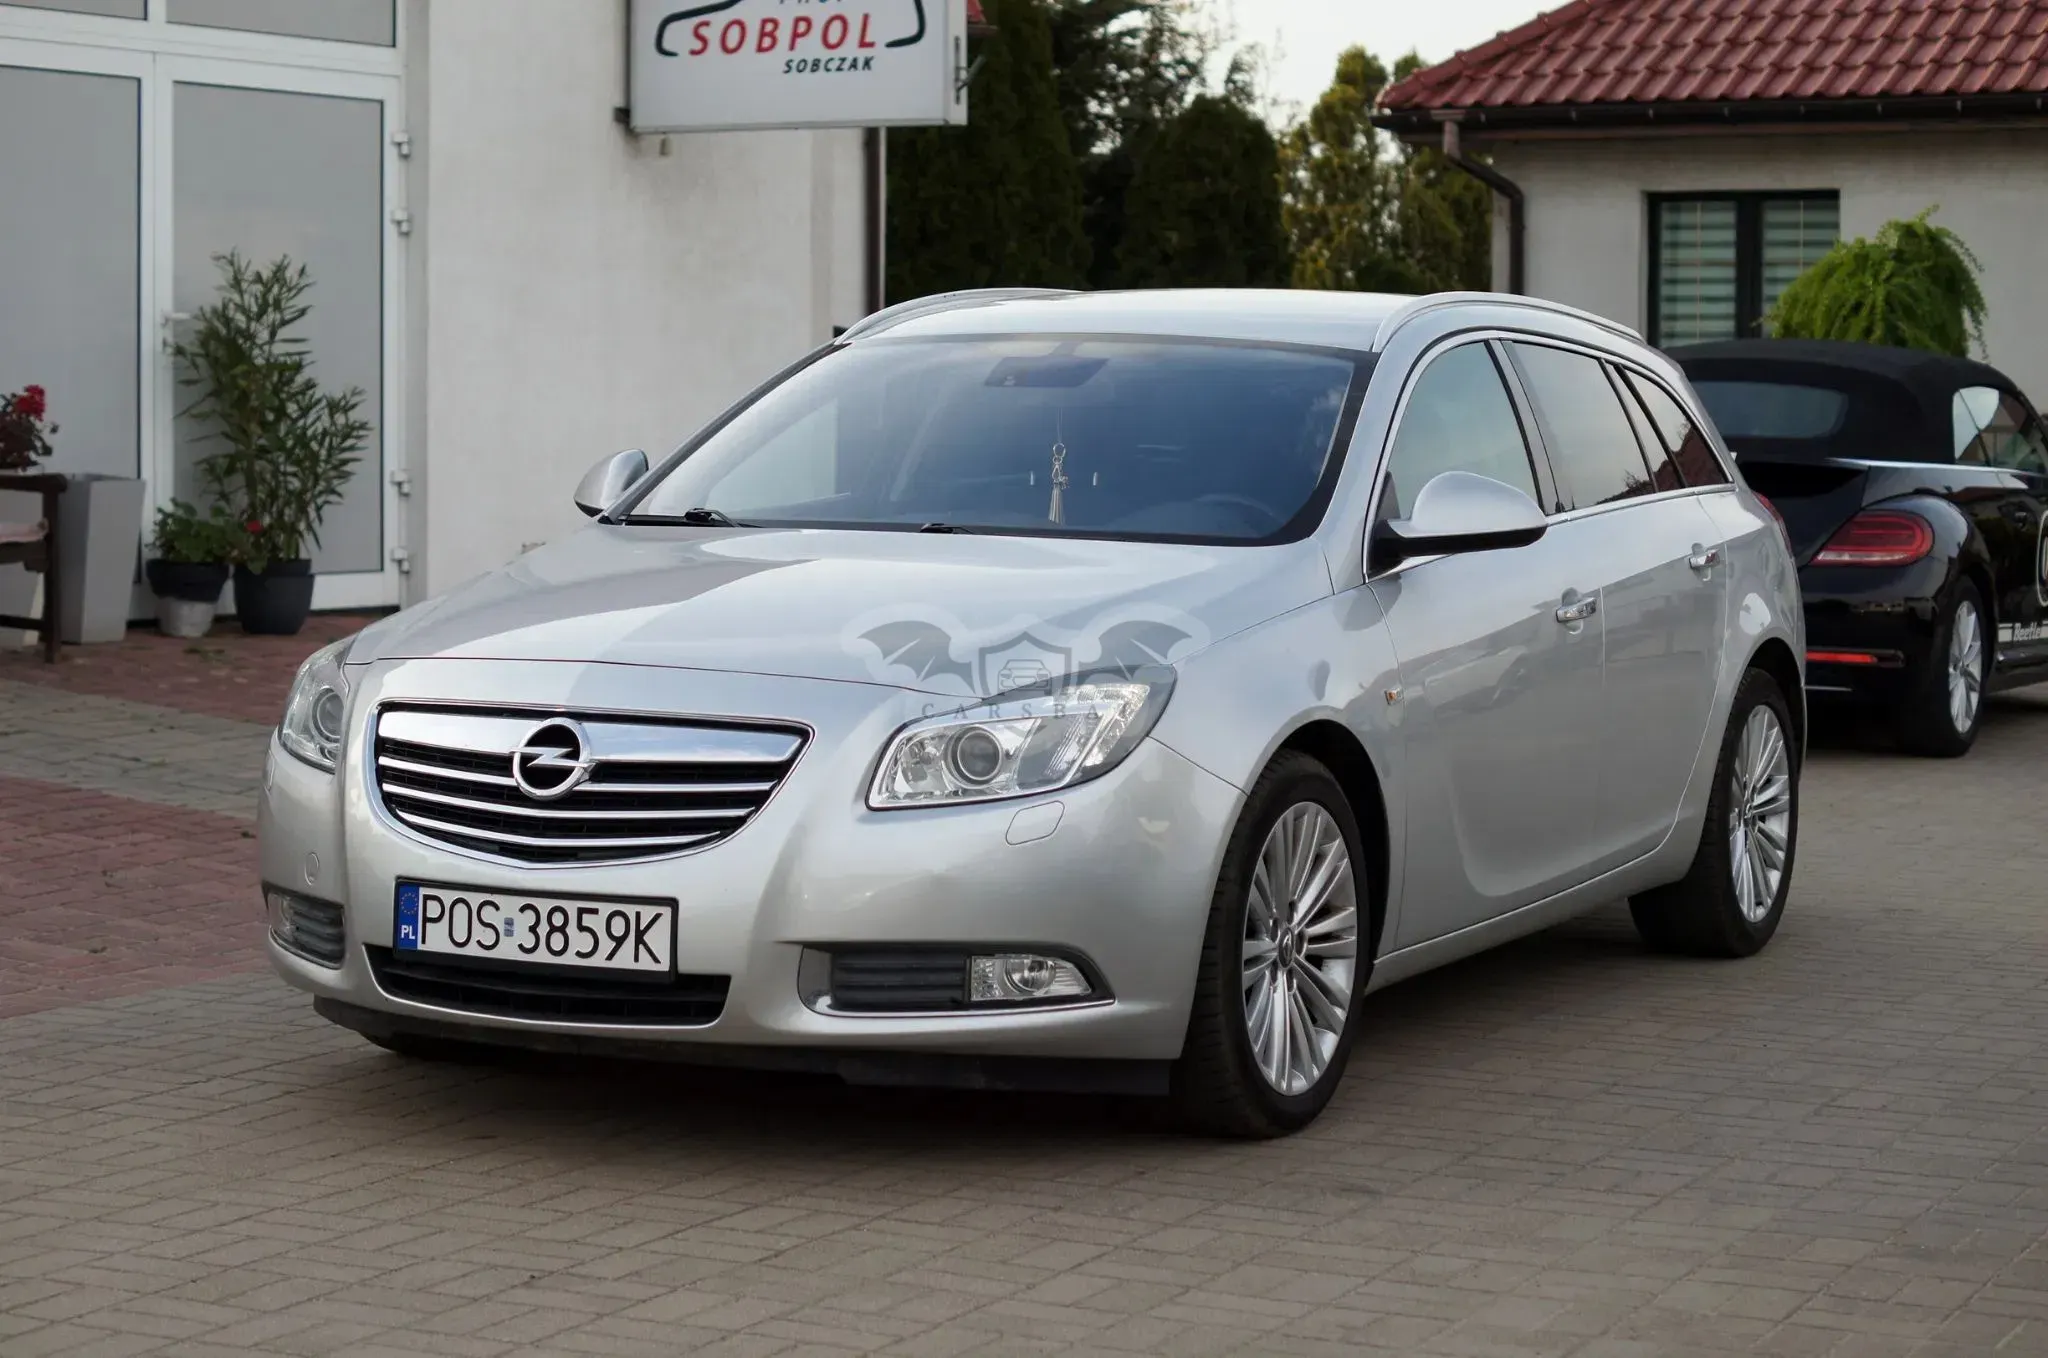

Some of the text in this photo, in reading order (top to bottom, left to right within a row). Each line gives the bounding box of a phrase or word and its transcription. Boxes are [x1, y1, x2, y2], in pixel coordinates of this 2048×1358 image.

[688, 13, 876, 56] SOBPOL
[782, 56, 875, 74] SOBCZAK
[2013, 621, 2042, 641] Beetle
[401, 925, 416, 940] PL
[421, 893, 664, 964] POS 3859K
